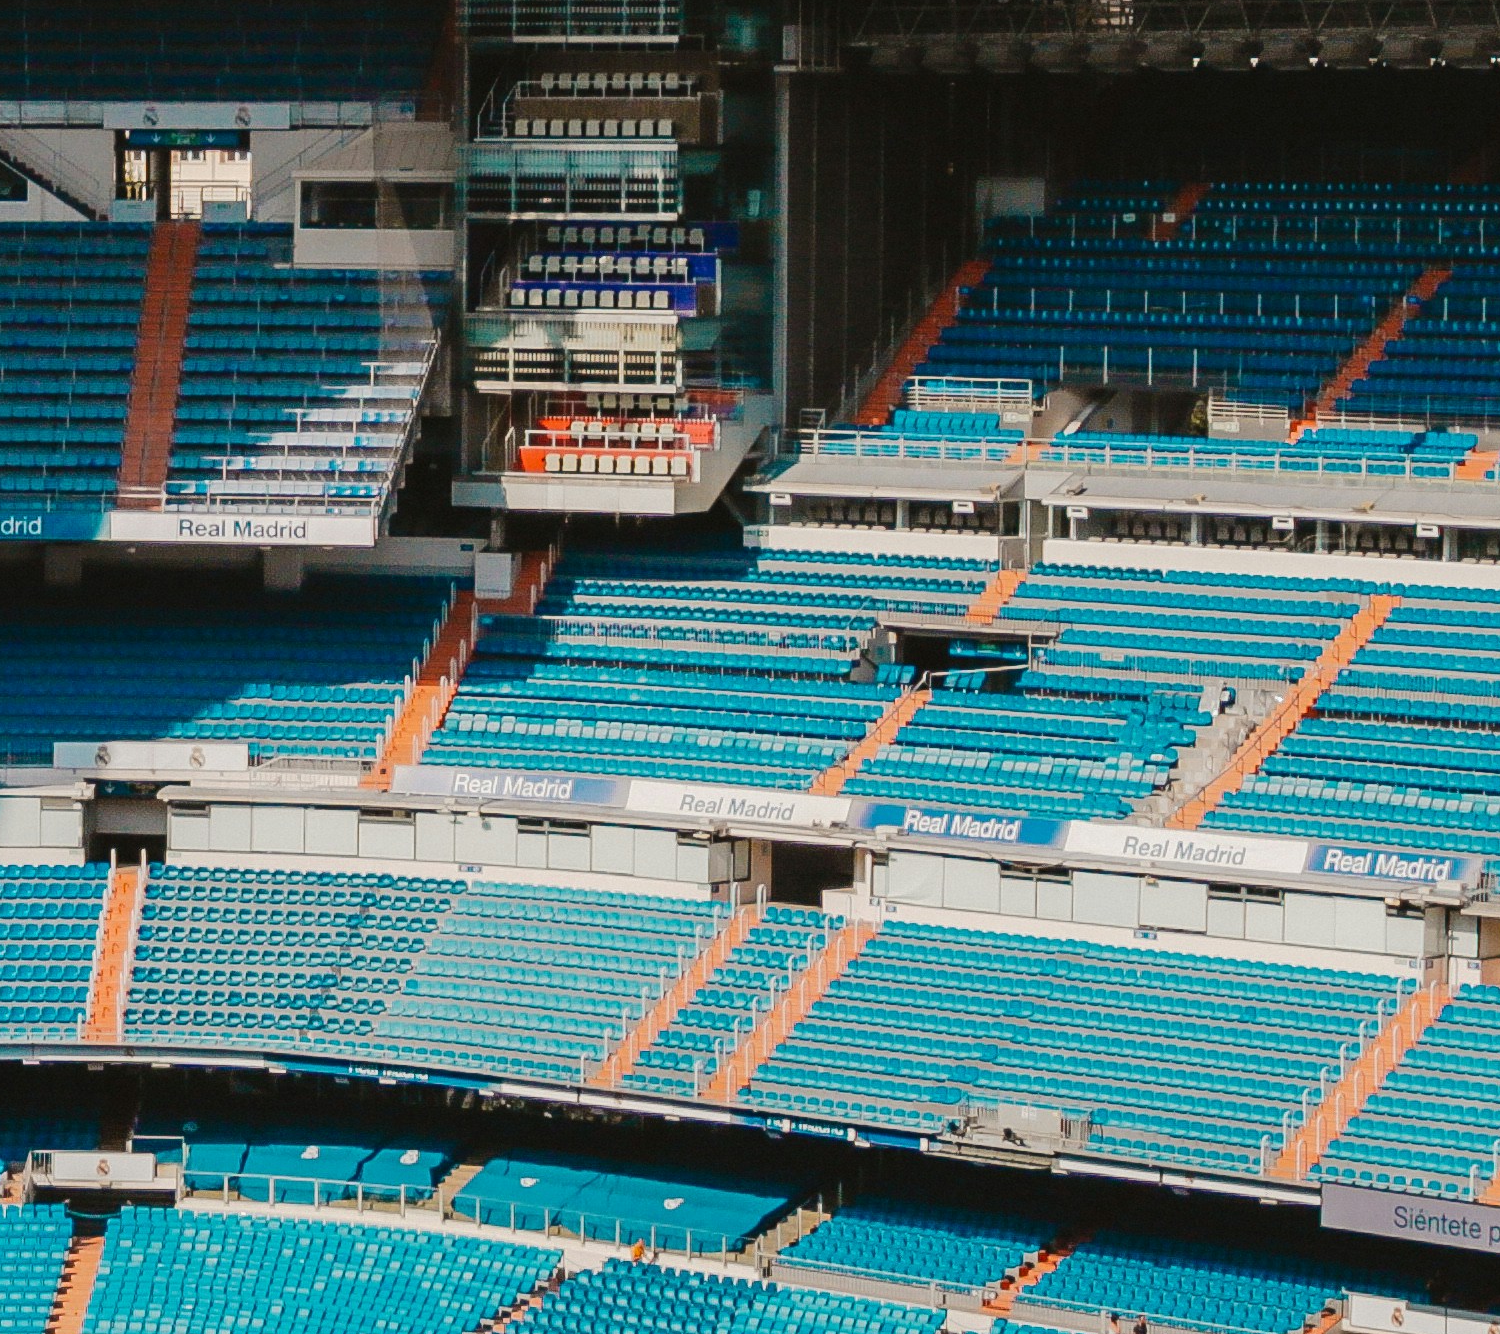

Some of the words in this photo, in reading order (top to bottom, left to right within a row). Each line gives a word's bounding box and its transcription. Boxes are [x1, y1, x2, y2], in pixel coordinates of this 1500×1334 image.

[178, 519, 225, 536] Real
[233, 520, 306, 539] Madrid
[453, 773, 498, 794] Real
[503, 775, 572, 799] Madrid
[680, 794, 723, 814] Real
[728, 798, 794, 821] Madrid
[905, 808, 947, 833] Real
[952, 814, 1018, 839] Madrid
[1123, 836, 1169, 858] Real
[1175, 841, 1246, 865] Madrid
[1324, 849, 1371, 873] Real
[1375, 854, 1449, 881] Madrid
[1394, 1205, 1482, 1240] Siéntete
